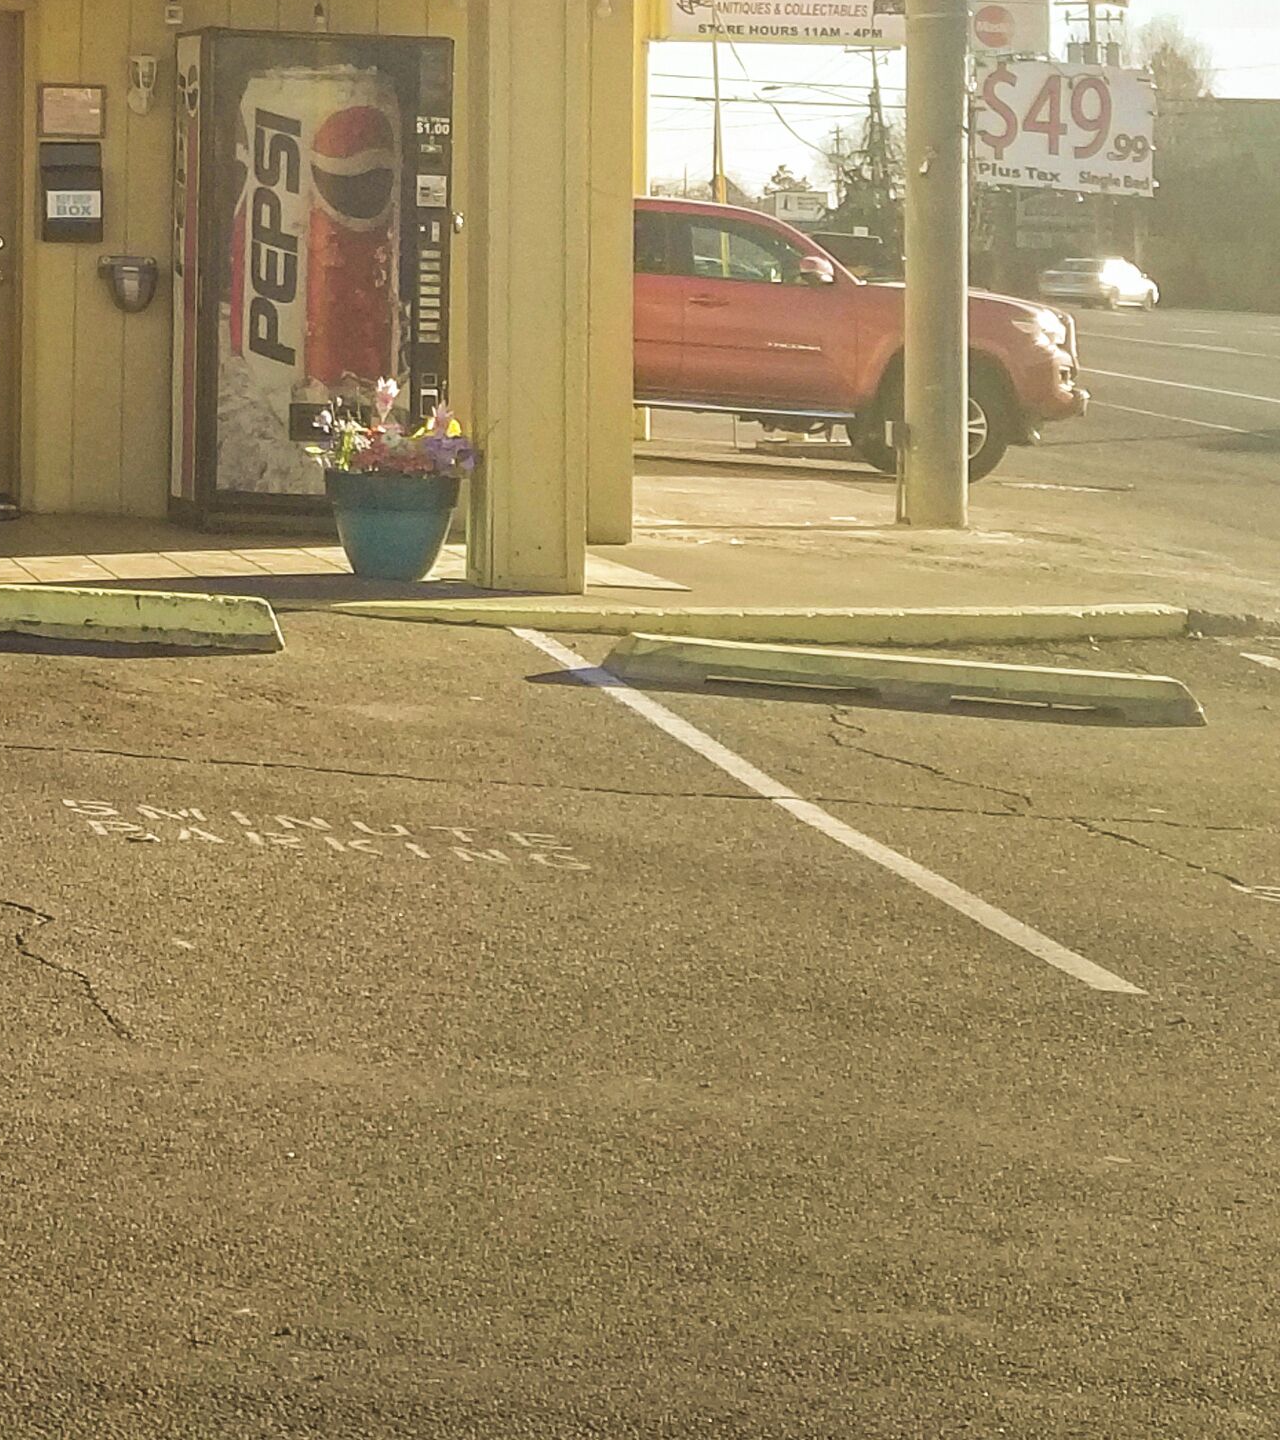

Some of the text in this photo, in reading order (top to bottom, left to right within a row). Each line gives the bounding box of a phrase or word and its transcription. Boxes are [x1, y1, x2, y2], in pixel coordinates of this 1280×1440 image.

[784, 3, 868, 18] COLLECTABLES
[698, 23, 745, 35] STORE
[749, 25, 799, 37] HOURS
[803, 26, 841, 37] 11AM
[853, 28, 883, 39] 4PM
[416, 121, 450, 134] $1.00
[978, 162, 1022, 179] Plus
[1025, 166, 1062, 183] Tax
[1079, 170, 1121, 190] Single
[56, 205, 92, 217] BOX
[249, 108, 303, 366] PEPSI
[86, 819, 594, 871] PARKING
